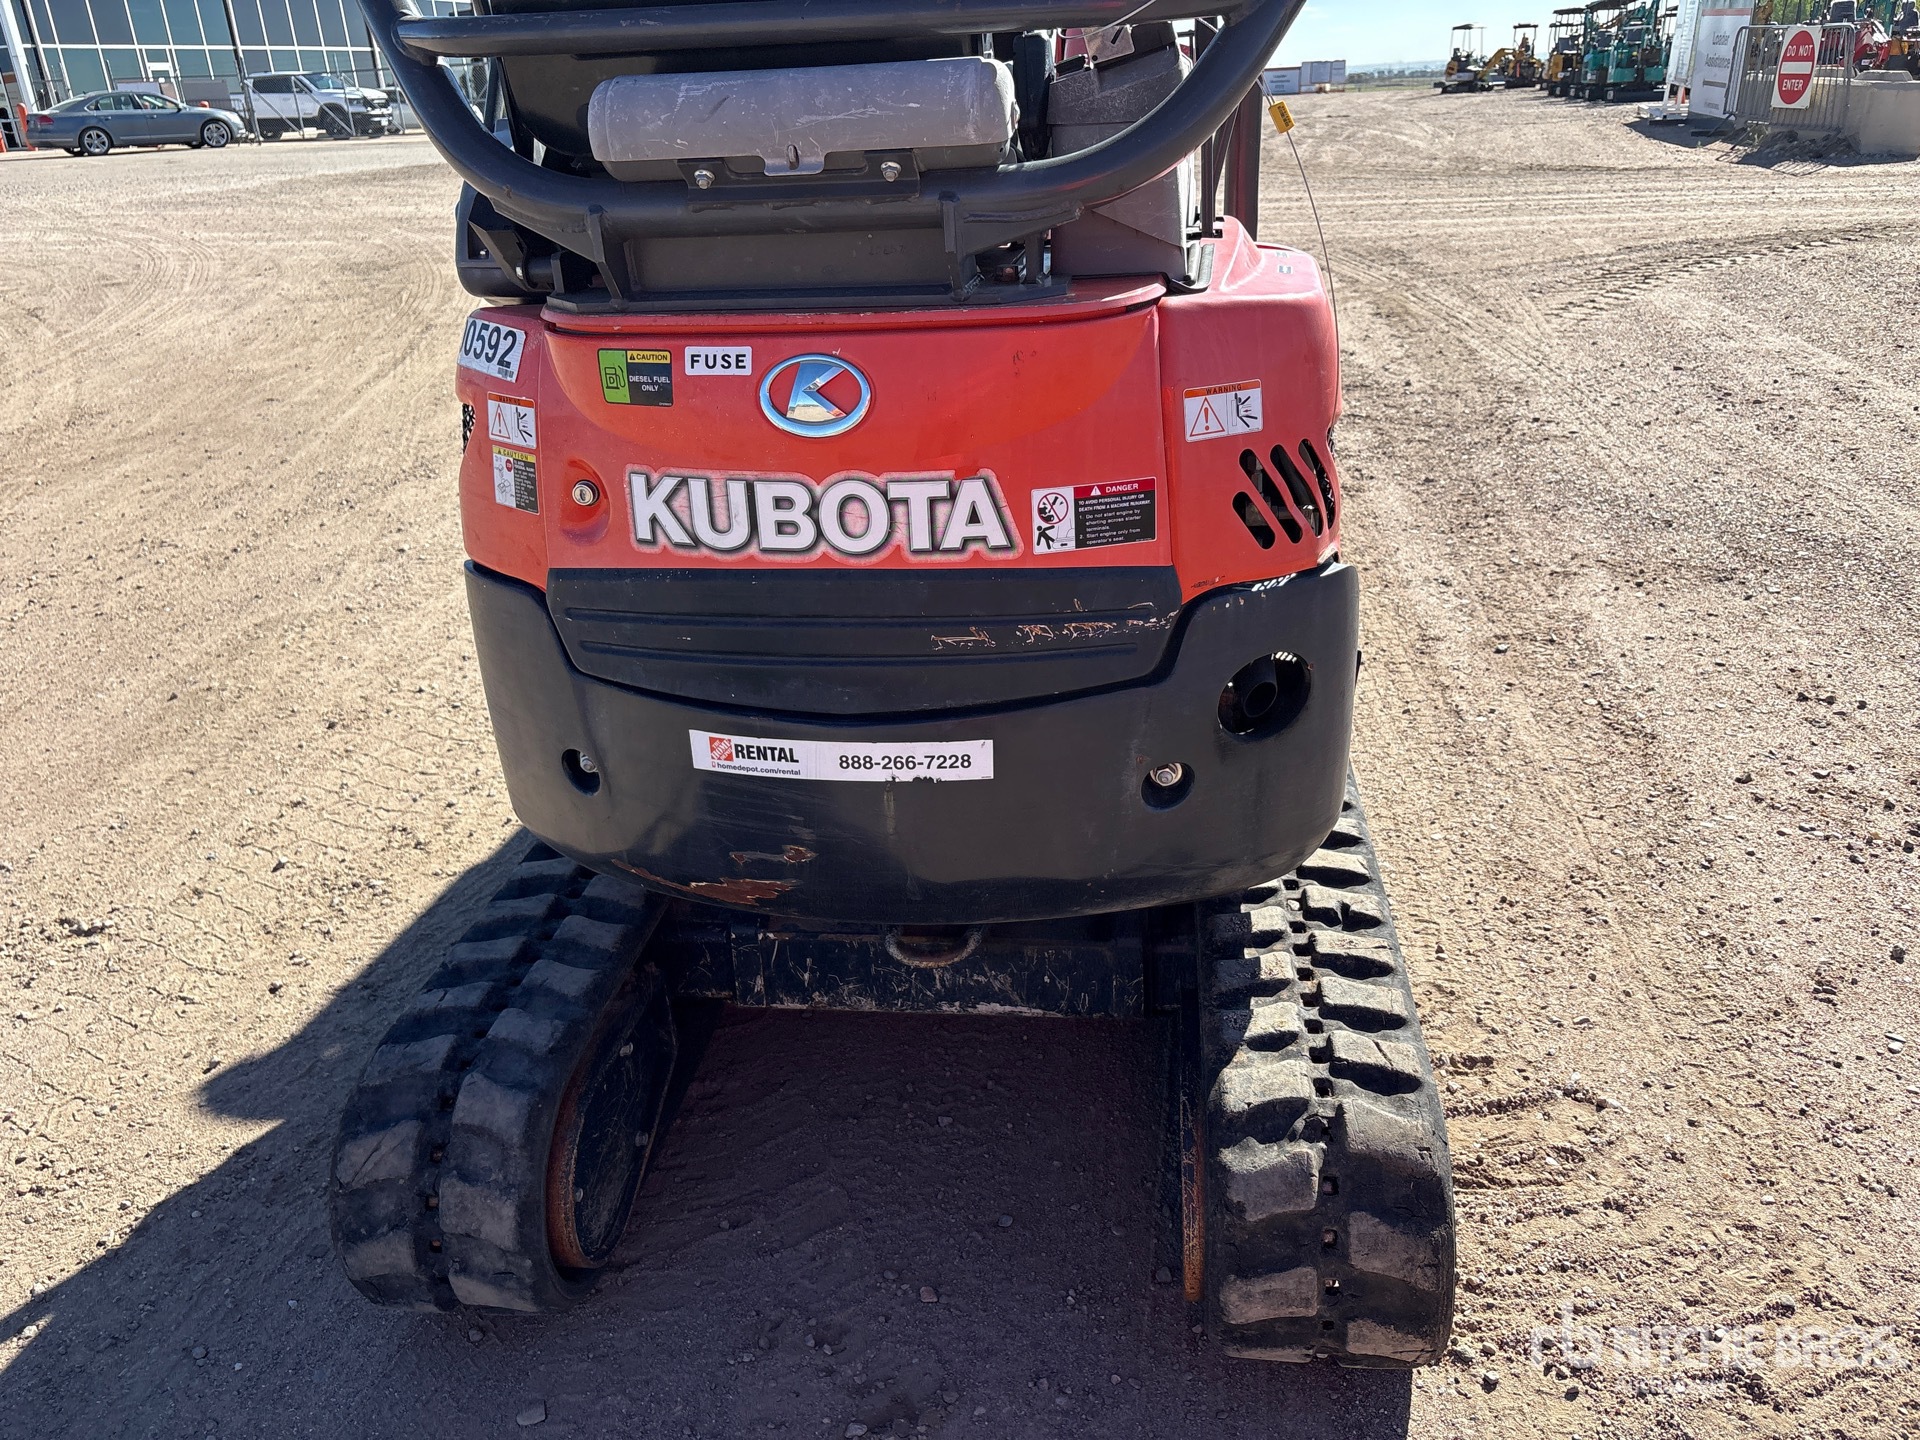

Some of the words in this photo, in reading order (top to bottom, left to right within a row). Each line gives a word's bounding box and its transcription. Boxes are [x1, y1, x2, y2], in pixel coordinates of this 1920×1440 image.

[1786, 45, 1797, 57] DO
[1798, 44, 1814, 57] NOT
[1781, 79, 1804, 91] ENTER
[464, 319, 517, 369] 0592
[636, 353, 668, 361] CAUTION
[690, 353, 746, 369] FUSE
[628, 375, 653, 383] DIESEL
[641, 384, 659, 392] ONLY
[1205, 383, 1242, 395] WARNING
[502, 449, 529, 461] CAUTION
[1105, 483, 1139, 493] DANGER
[628, 471, 1013, 555] KUBOTA
[733, 743, 799, 763] RENTAL
[838, 753, 972, 770] 888-266-7228
[717, 762, 801, 776] homedepot.com/rental
